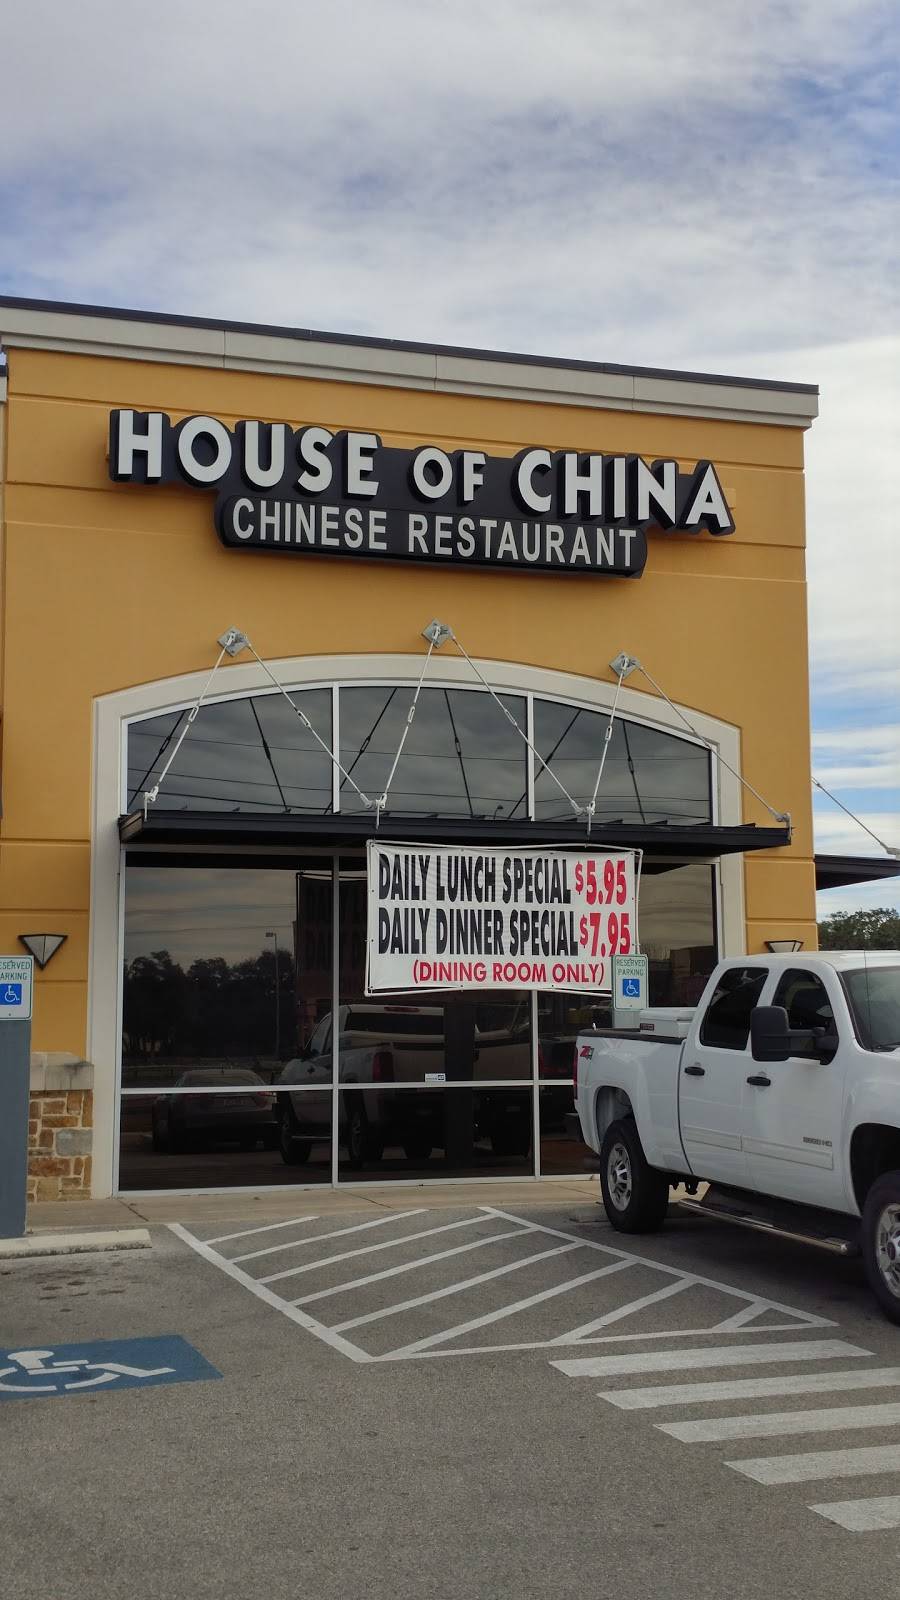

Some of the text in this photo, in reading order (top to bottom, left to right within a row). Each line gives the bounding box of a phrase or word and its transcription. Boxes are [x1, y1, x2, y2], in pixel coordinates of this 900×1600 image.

[118, 410, 731, 528] HOUSE OF CHINA
[233, 498, 637, 567] CHINESE RESTAURANT
[378, 854, 627, 905] DAILY LUNCH SPECIAL $5.95
[378, 907, 630, 957] DAILY DINNER SPECIAL $7.95
[0, 961, 30, 970] SERVED
[413, 960, 604, 985] (DINING ROOM ONLY)
[616, 959, 645, 967] RESERVED
[618, 968, 643, 976] PARKING
[0, 972, 27, 980] ARKING
